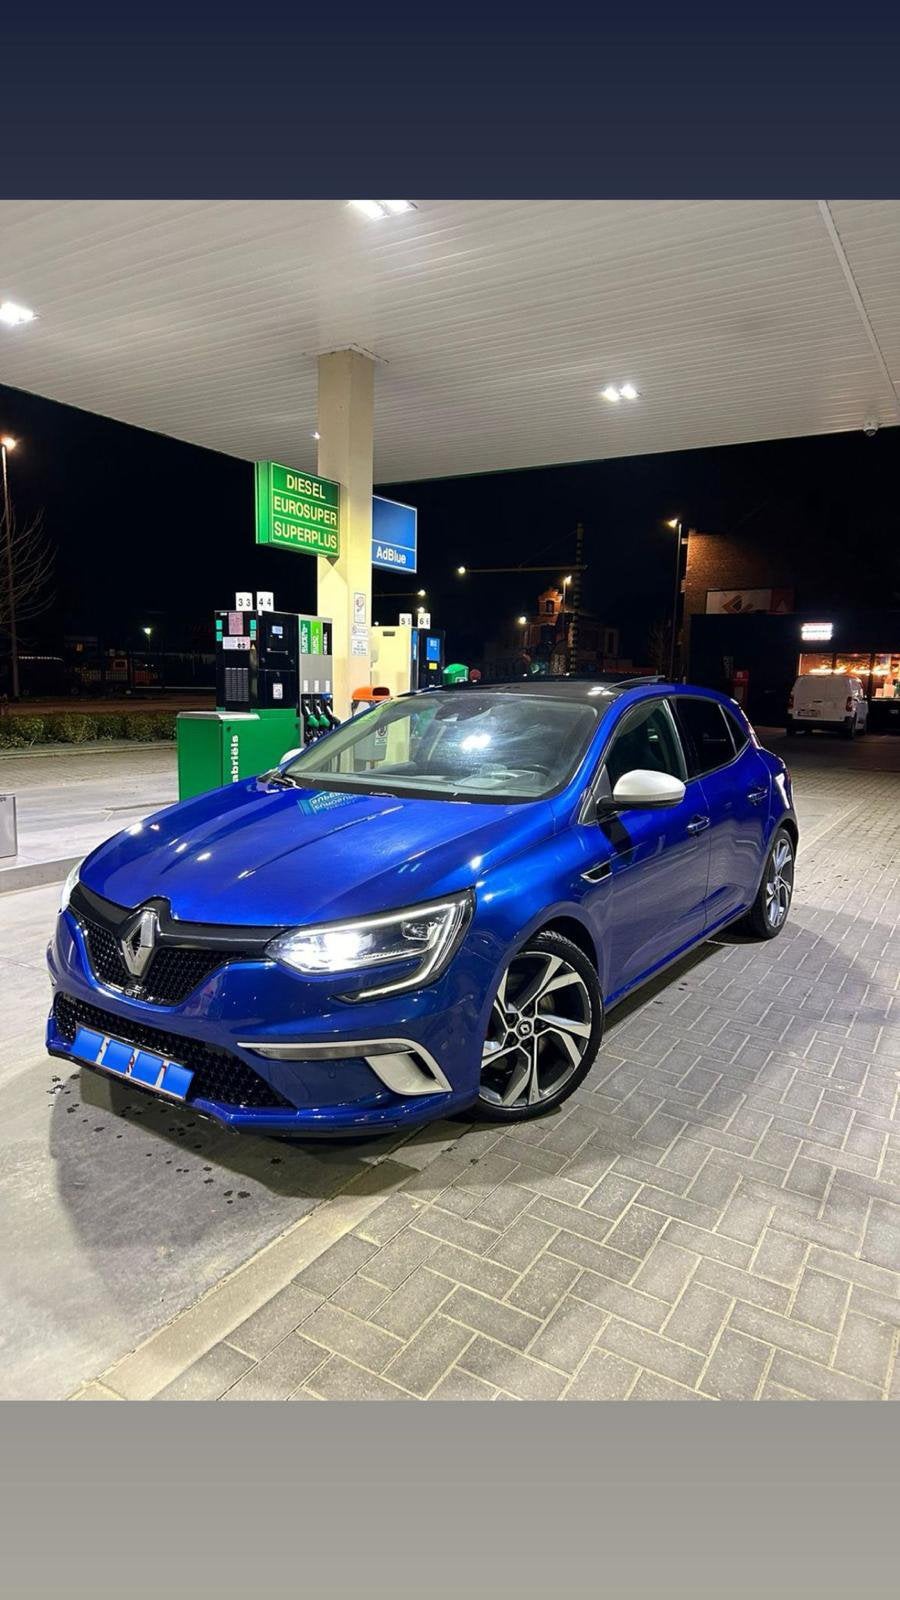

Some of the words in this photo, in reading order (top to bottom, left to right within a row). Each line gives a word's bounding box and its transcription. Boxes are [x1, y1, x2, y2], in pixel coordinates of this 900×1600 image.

[286, 474, 326, 499] DIESEL
[273, 496, 337, 526] EUROSUPER
[273, 521, 337, 549] SUPERPLUS
[376, 547, 406, 564] AdBlue
[230, 734, 239, 783] abriëls
[124, 988, 141, 998] GT
